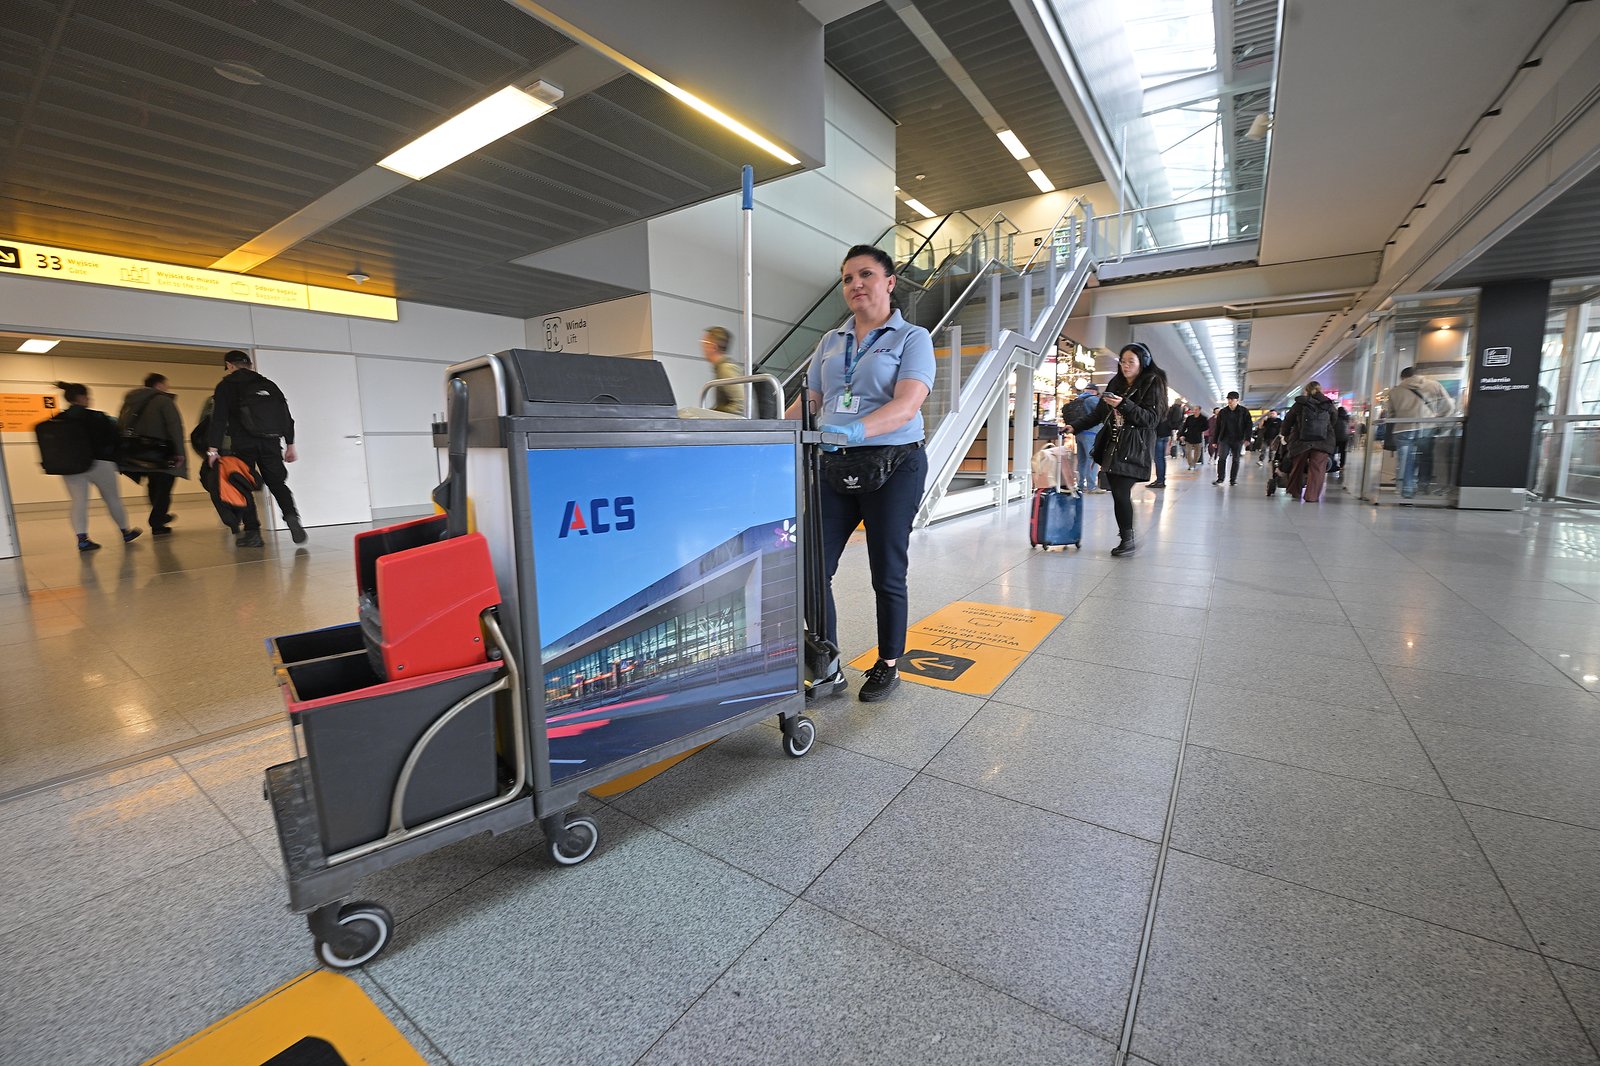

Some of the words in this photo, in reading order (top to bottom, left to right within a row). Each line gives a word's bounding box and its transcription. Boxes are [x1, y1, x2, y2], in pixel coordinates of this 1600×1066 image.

[36, 253, 63, 271] 33
[566, 318, 586, 330] Winda
[566, 333, 578, 344] Lift
[558, 495, 636, 539] ACS
[923, 627, 958, 635] miasta
[994, 632, 1015, 640] Exit
[976, 635, 1019, 646] Wyjście
